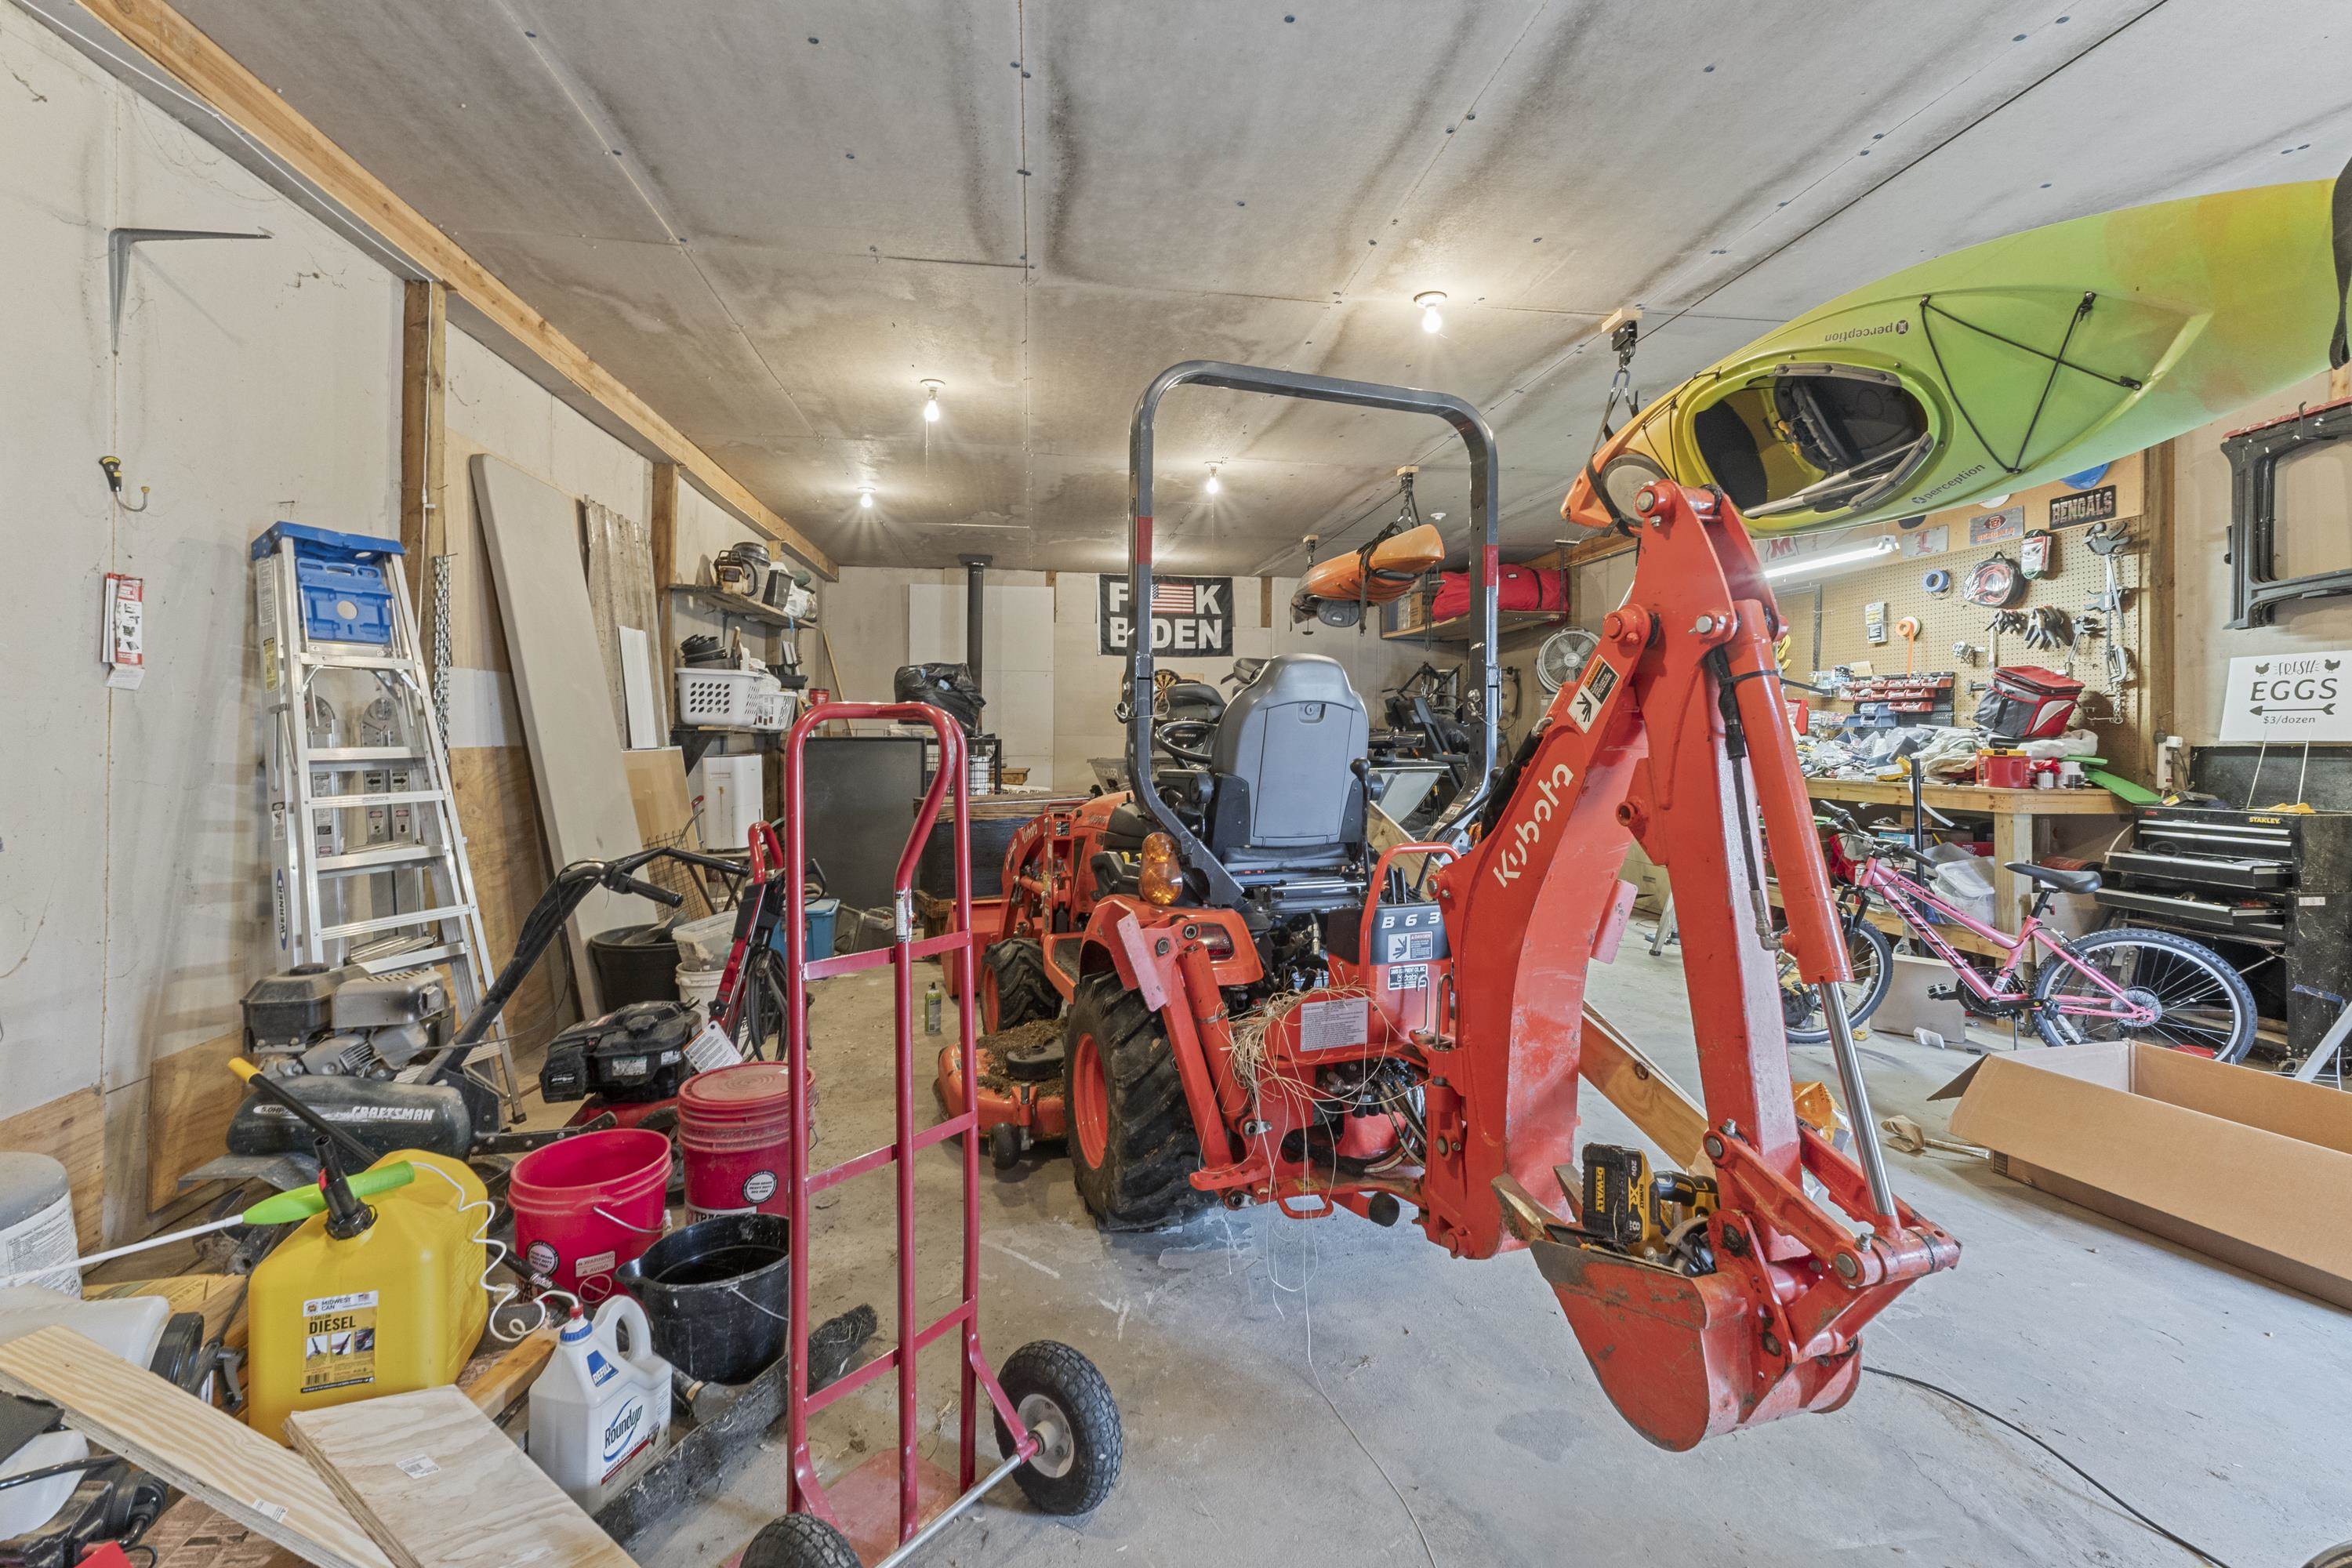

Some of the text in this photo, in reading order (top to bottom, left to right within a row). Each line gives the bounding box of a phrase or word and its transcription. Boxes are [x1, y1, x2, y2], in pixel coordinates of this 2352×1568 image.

[1824, 321, 1893, 343] perception
[1924, 463, 1986, 500] perception
[2051, 490, 2114, 524] BENGALS
[1109, 617, 1223, 649] BDEN
[2278, 660, 2316, 676] FRESH
[2250, 678, 2338, 702] EGGS
[2263, 716, 2316, 724] $3/dozen
[1493, 764, 1574, 887] Kubota
[353, 1105, 435, 1121] CRAFTSMAN
[1632, 1221, 1641, 1231] 8
[584, 1253, 615, 1265] WARNING
[309, 1316, 356, 1334] DIESEL
[593, 1362, 612, 1384] REFILL
[604, 1405, 643, 1449] Roundup
